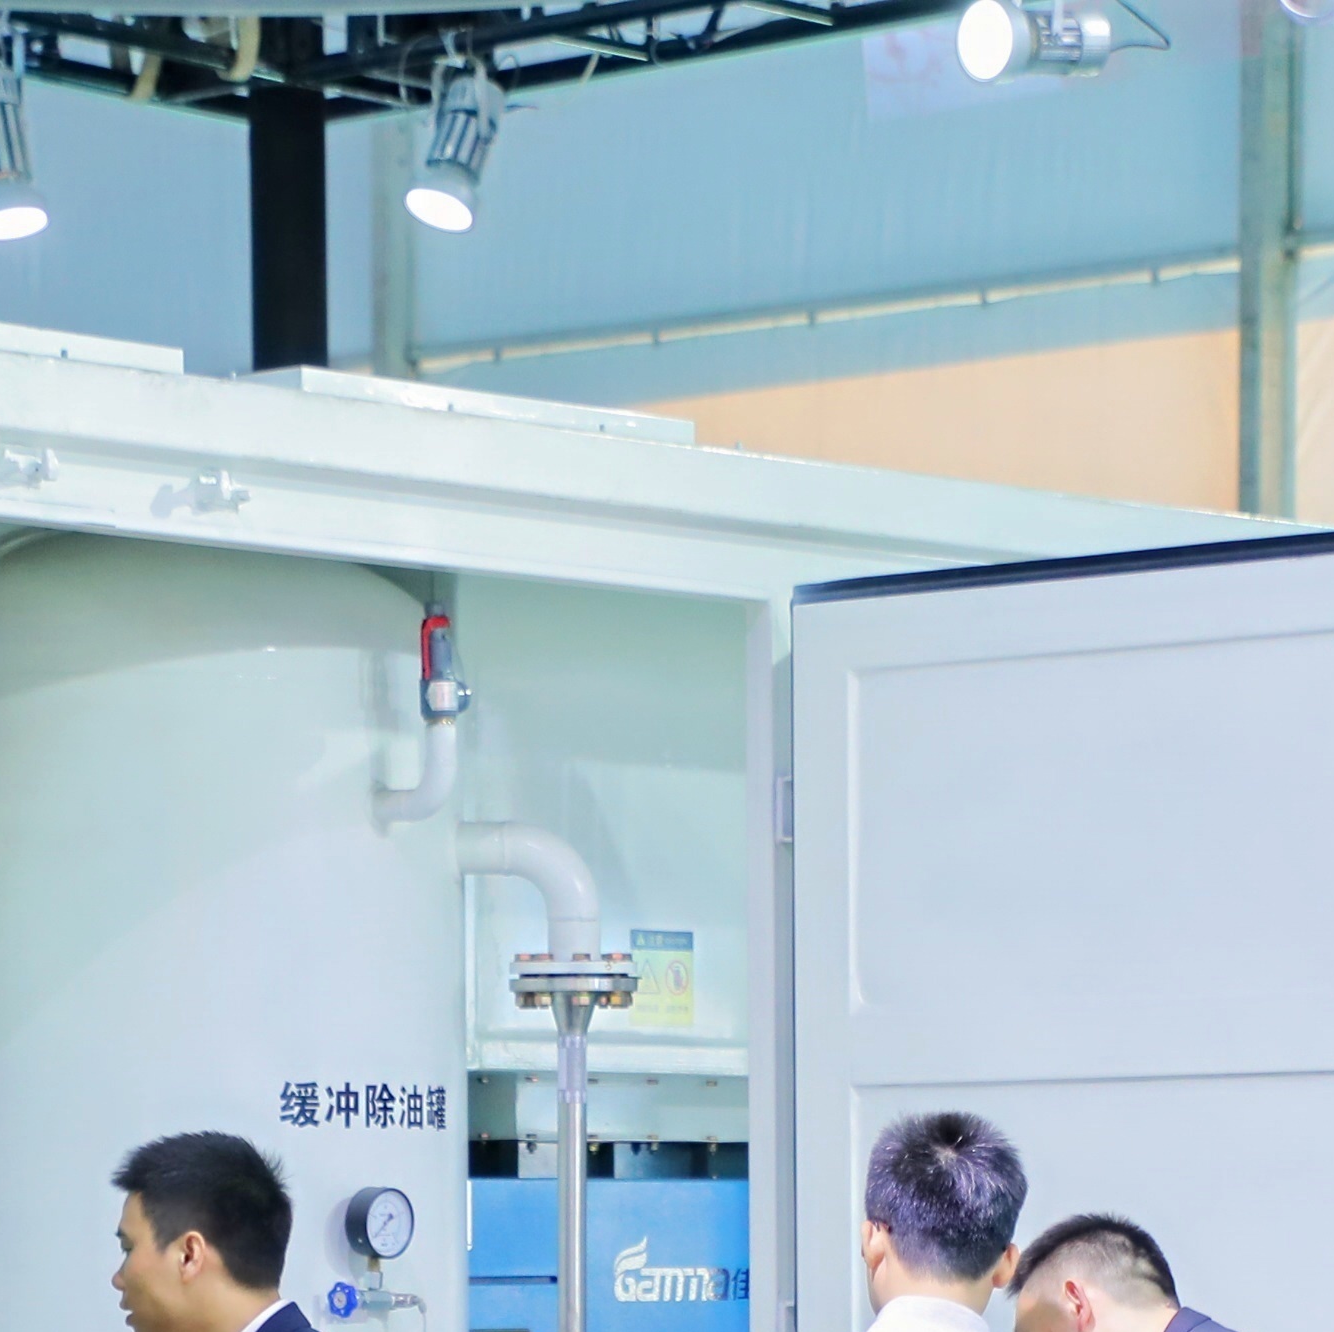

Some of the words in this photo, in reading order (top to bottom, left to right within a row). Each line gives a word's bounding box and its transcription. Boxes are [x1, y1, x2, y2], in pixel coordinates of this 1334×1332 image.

[279, 1082, 446, 1131] 缓冲除油罐
